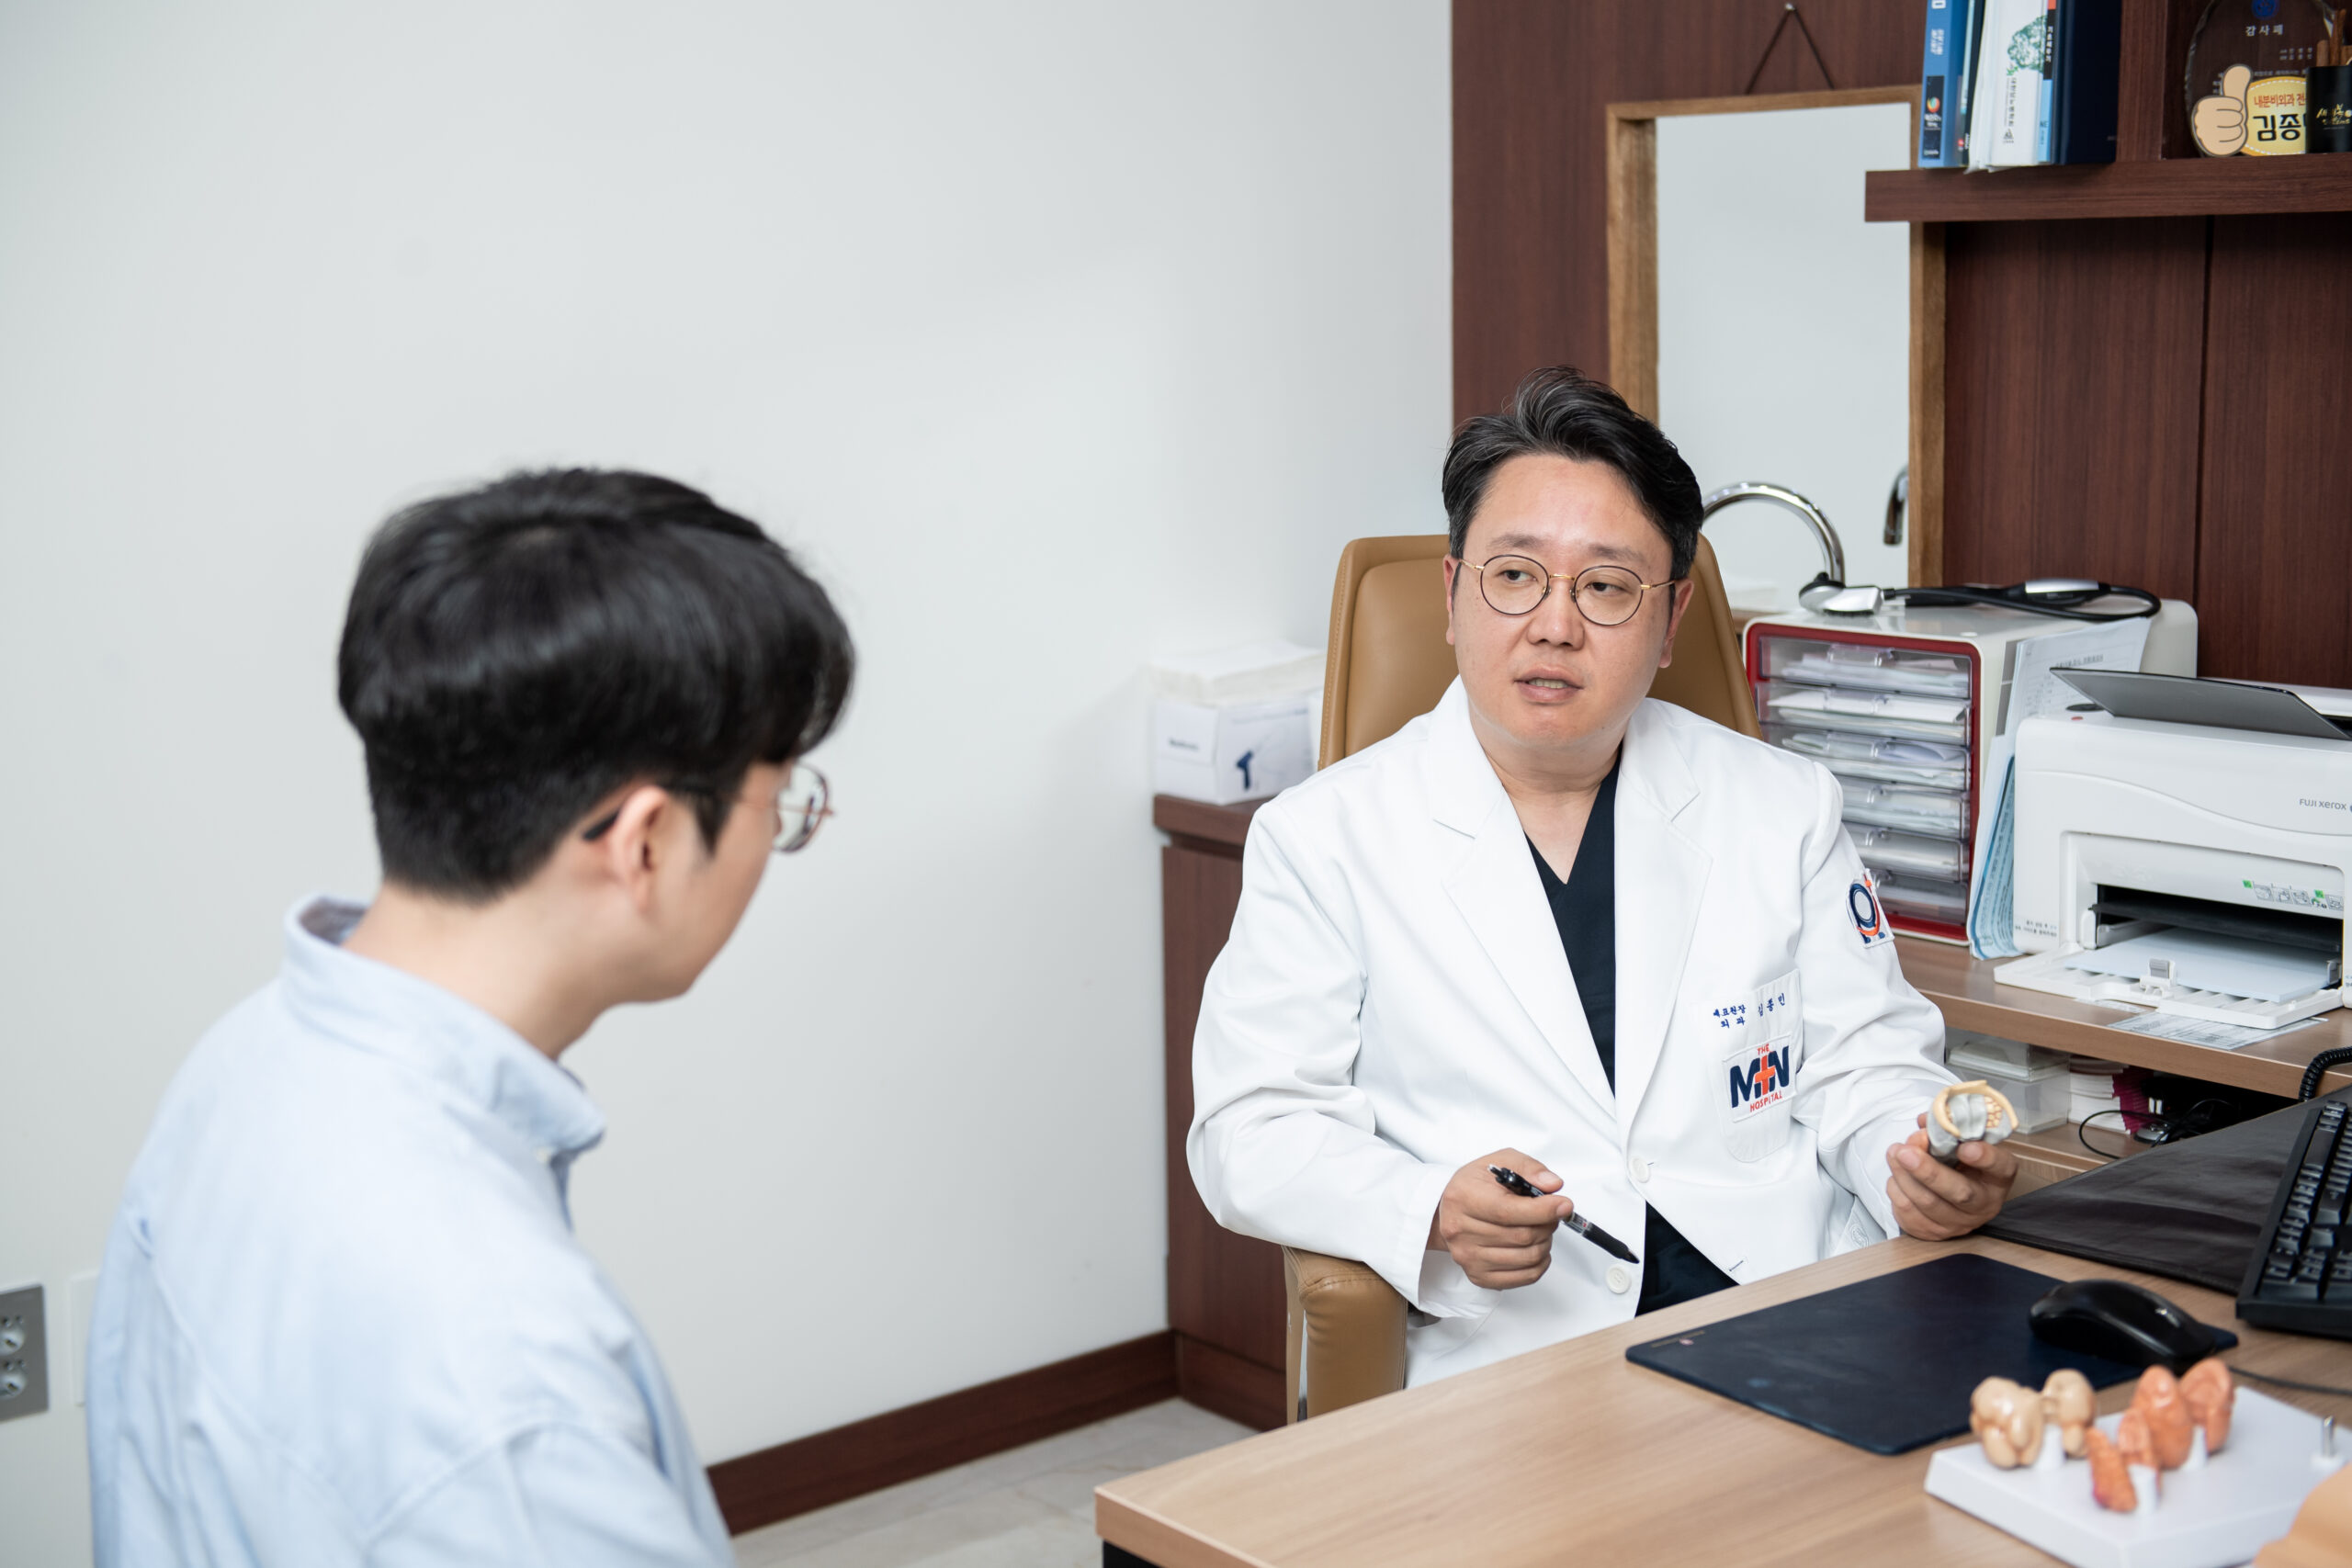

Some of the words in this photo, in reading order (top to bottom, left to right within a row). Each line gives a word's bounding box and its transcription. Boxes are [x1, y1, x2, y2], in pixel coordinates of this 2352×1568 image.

[2245, 24, 2284, 37] 감사패
[2254, 93, 2295, 107] 내분비외과
[2296, 93, 2307, 106] 전
[2253, 113, 2307, 141] 김종
[2300, 798, 2317, 807] FUJI
[2318, 800, 2346, 810] xerox
[1758, 1043, 1770, 1055] THE
[1749, 1092, 1782, 1112] HOSPITAL
